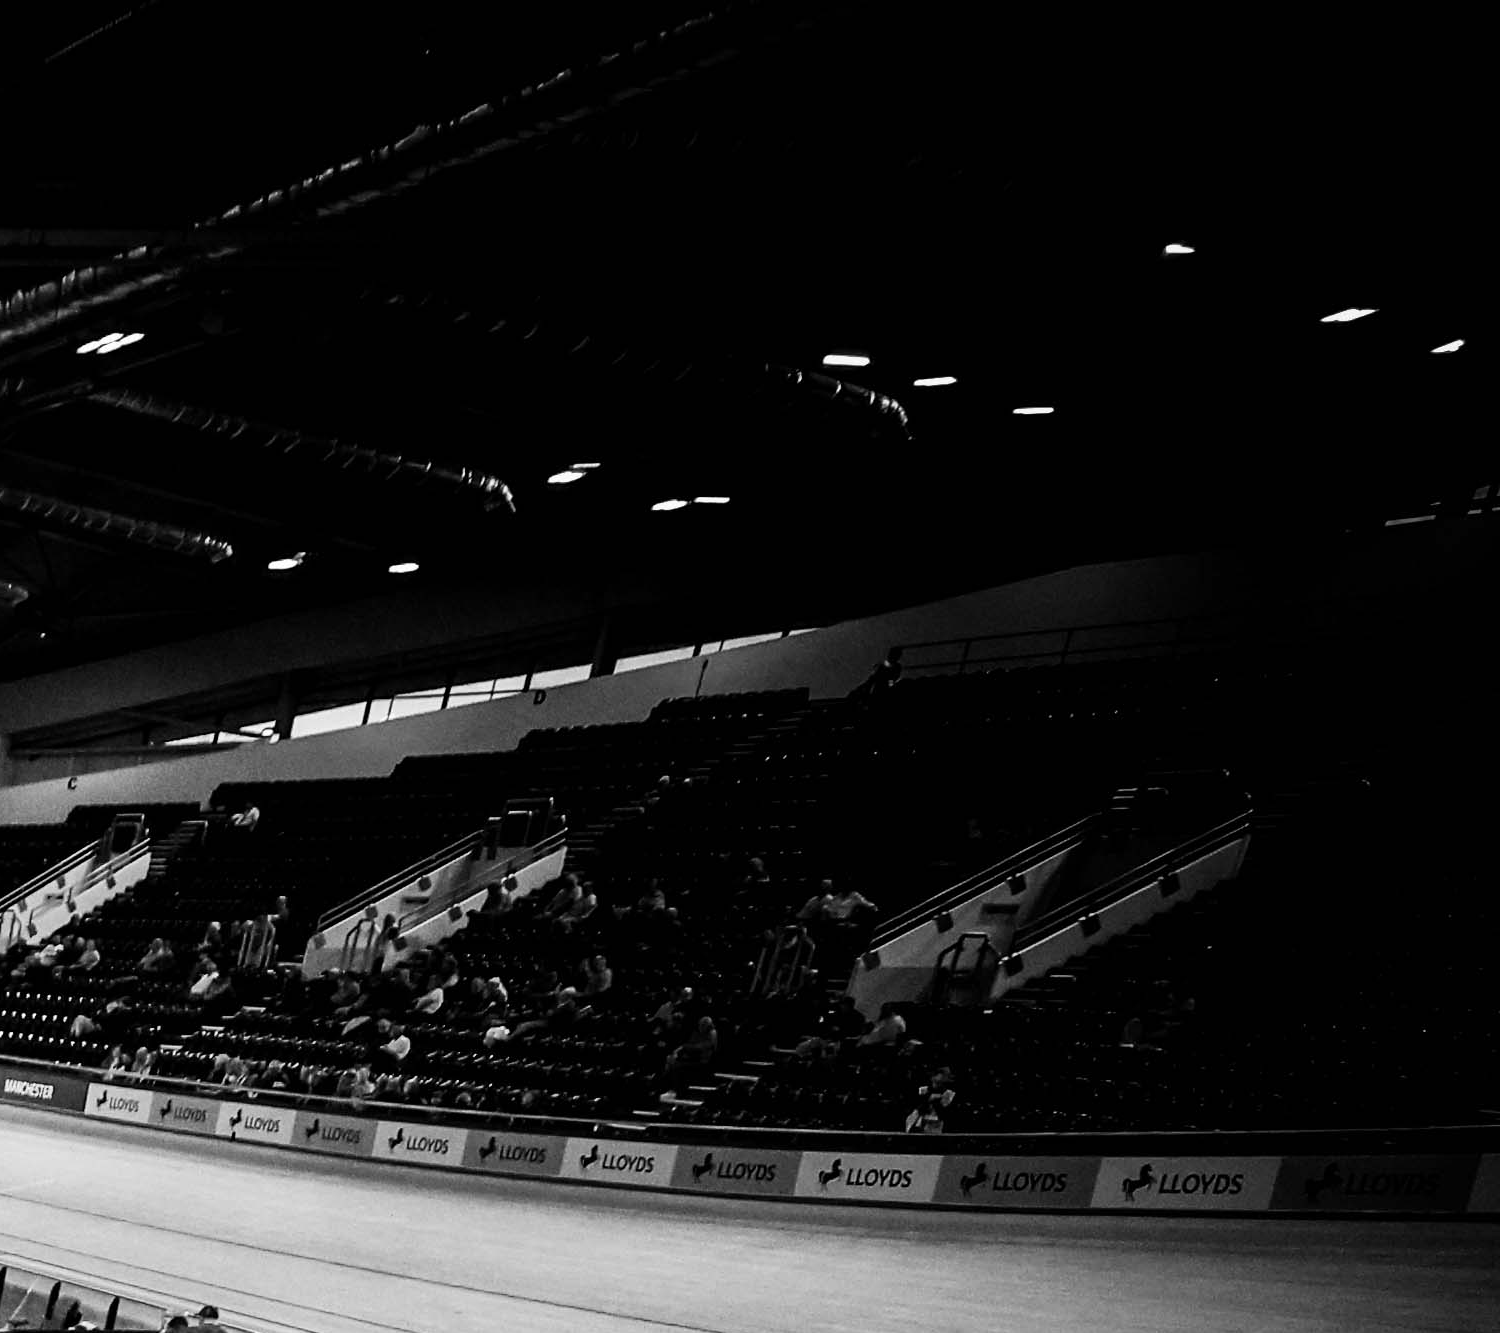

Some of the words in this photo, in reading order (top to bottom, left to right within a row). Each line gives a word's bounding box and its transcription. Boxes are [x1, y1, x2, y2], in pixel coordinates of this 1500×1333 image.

[4, 1078, 54, 1101] MANCHESTER
[108, 1095, 140, 1113] LLOYDS
[174, 1105, 208, 1123] LLOYDS
[244, 1116, 281, 1134] LLOYDS
[321, 1126, 362, 1146] LLOYDS
[405, 1134, 450, 1156] LLOYDS
[499, 1144, 548, 1166] LLOYDS
[601, 1153, 655, 1174] LLOYDS
[716, 1160, 778, 1182] LLOYDS
[845, 1167, 913, 1188] LLOYDS
[991, 1172, 1068, 1193] LLOYDS
[1157, 1173, 1244, 1195] LLOYDS
[1344, 1172, 1443, 1197] LLOYDS
